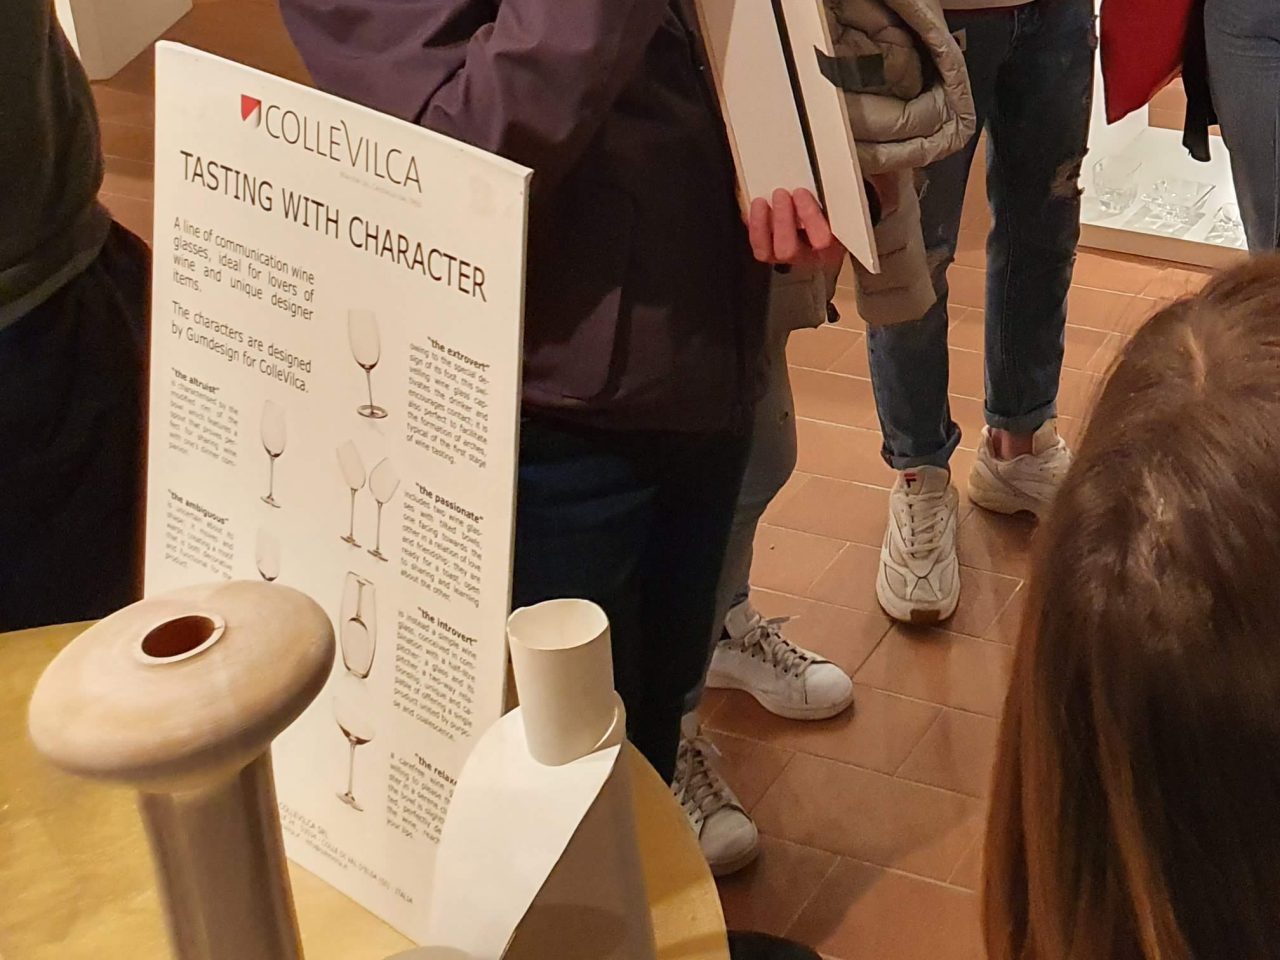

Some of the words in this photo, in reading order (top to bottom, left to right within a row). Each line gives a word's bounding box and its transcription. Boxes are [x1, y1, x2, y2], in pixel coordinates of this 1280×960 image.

[265, 105, 422, 193] COLLEVILCA
[174, 217, 180, 230] A
[183, 220, 200, 238] line
[203, 229, 213, 242] of
[215, 235, 288, 274] communication
[292, 265, 314, 285] wine
[180, 150, 273, 212] TASTING
[282, 187, 340, 239] WITH
[349, 216, 487, 302] CHARACTER
[173, 271, 201, 292] items.
[174, 236, 211, 262] glasses,
[219, 253, 241, 272] ideal
[248, 263, 262, 279] for
[268, 272, 297, 296] lovers
[304, 289, 314, 302] of
[174, 254, 195, 271] wine
[204, 267, 221, 282] and
[230, 277, 262, 299] unique
[271, 292, 313, 320] designer
[172, 300, 189, 320] The
[194, 312, 243, 342] characters
[248, 336, 263, 352] are
[268, 343, 311, 373] designed
[172, 321, 183, 339] by
[186, 327, 239, 362] Gumdesign
[243, 351, 256, 367] for
[260, 359, 308, 392] ColleVilca.
